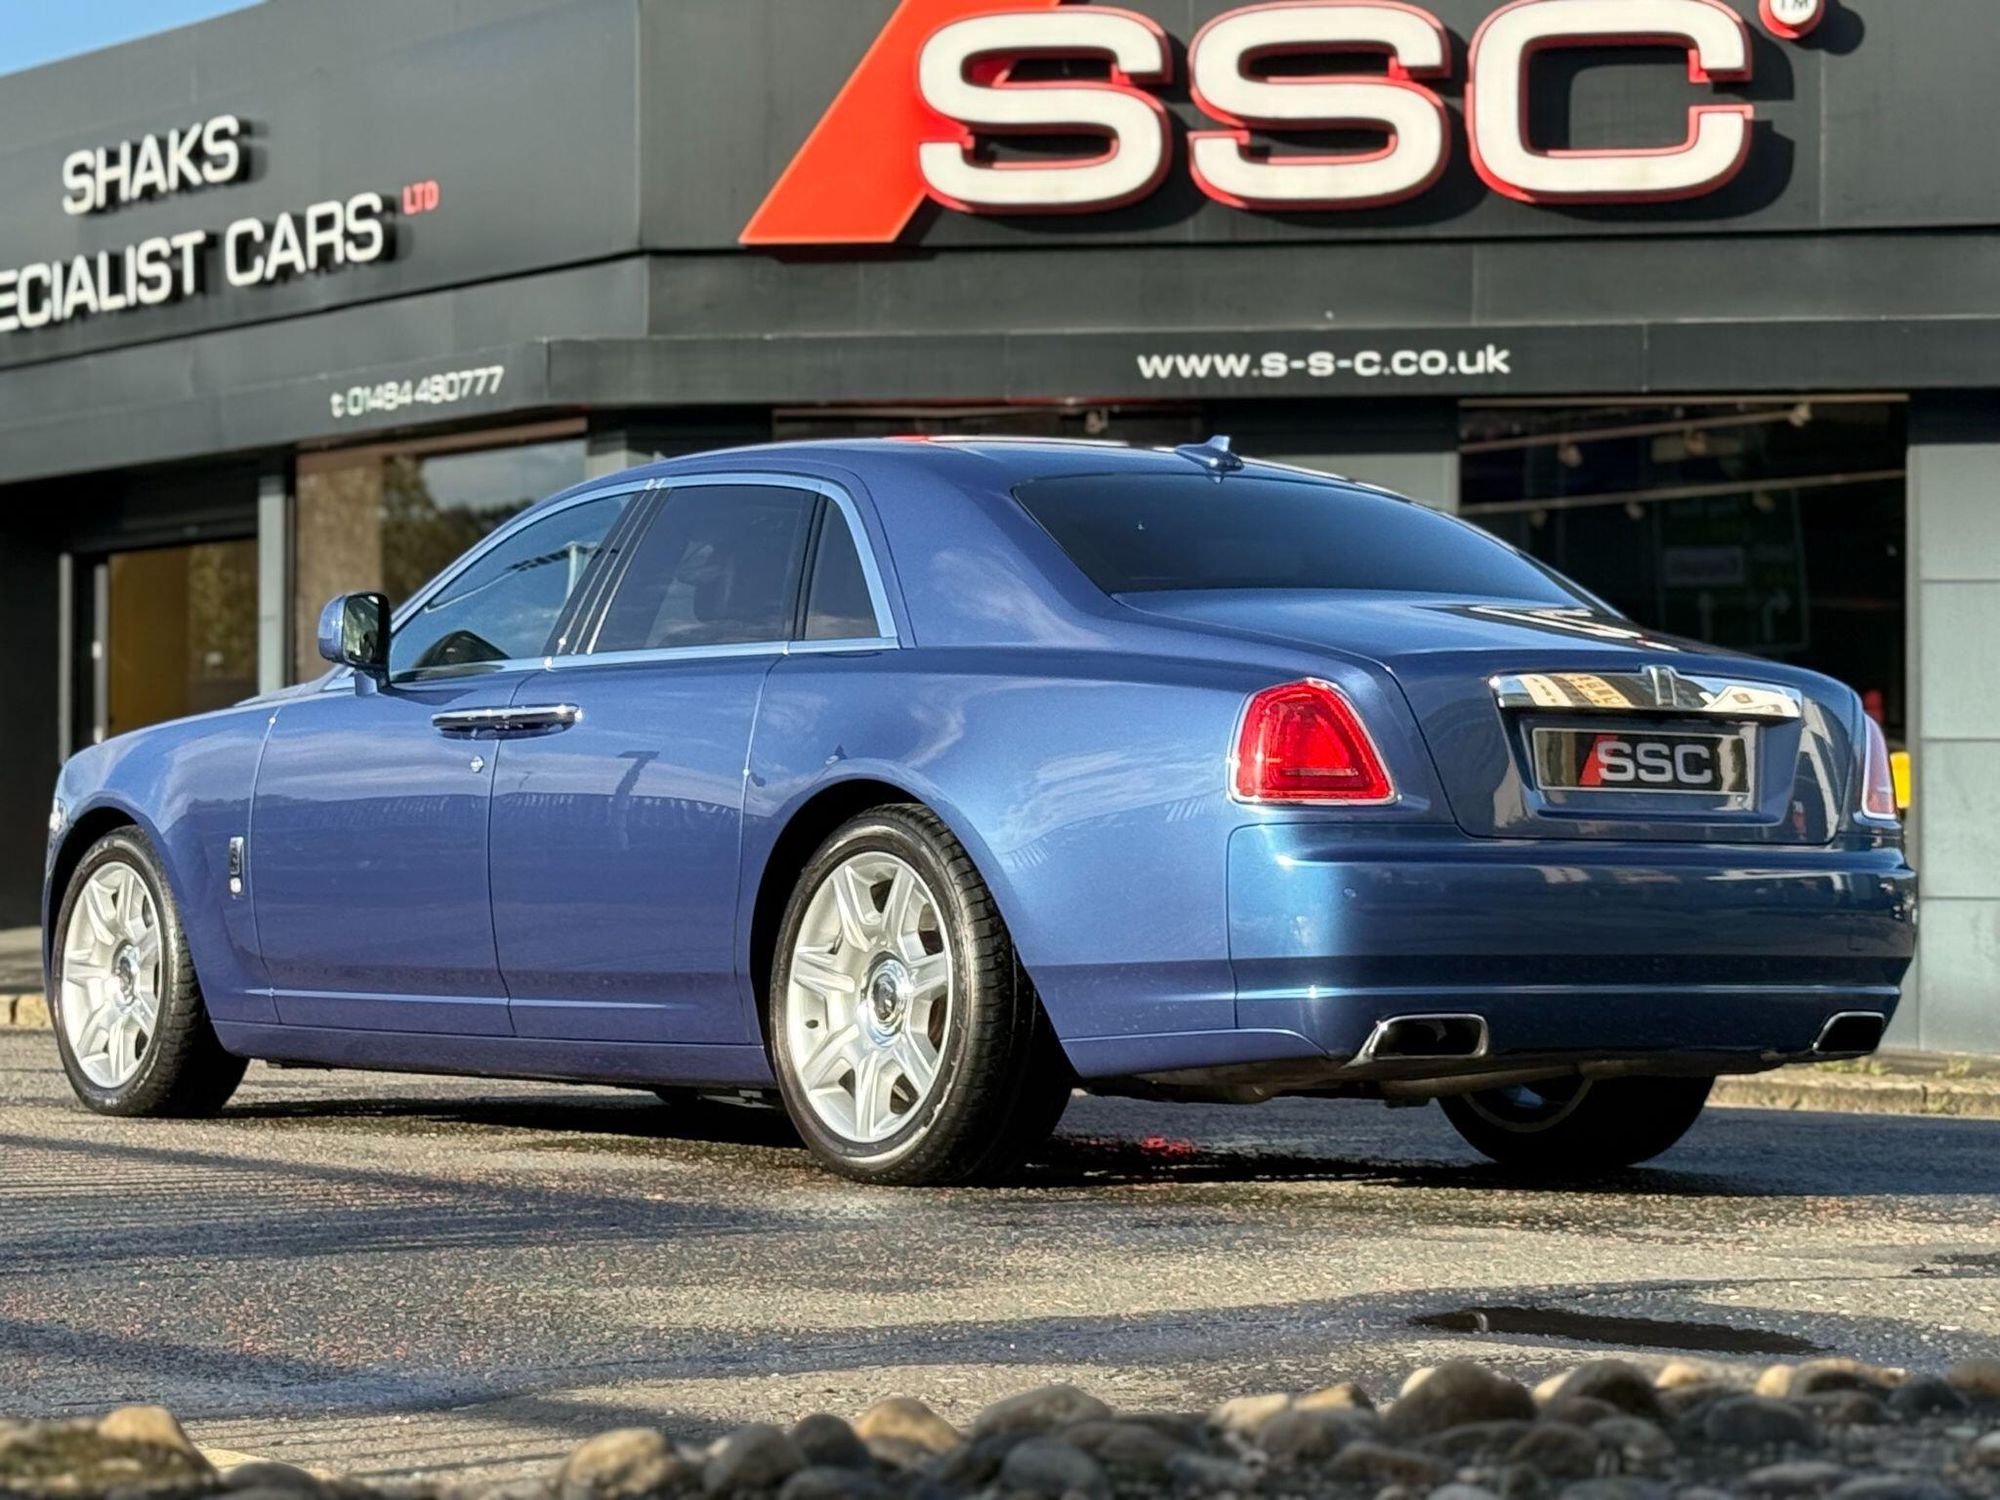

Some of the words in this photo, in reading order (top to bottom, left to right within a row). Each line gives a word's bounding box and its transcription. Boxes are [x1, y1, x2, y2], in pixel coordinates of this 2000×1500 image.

[918, 0, 1755, 212] SSC
[62, 114, 240, 215] SHAKS
[0, 229, 206, 332] ECIALIST
[224, 192, 384, 286] CARS
[403, 180, 440, 215] LTD
[1136, 344, 1511, 378] www.s-s-c.co.uk
[1597, 741, 1713, 784] SSC
